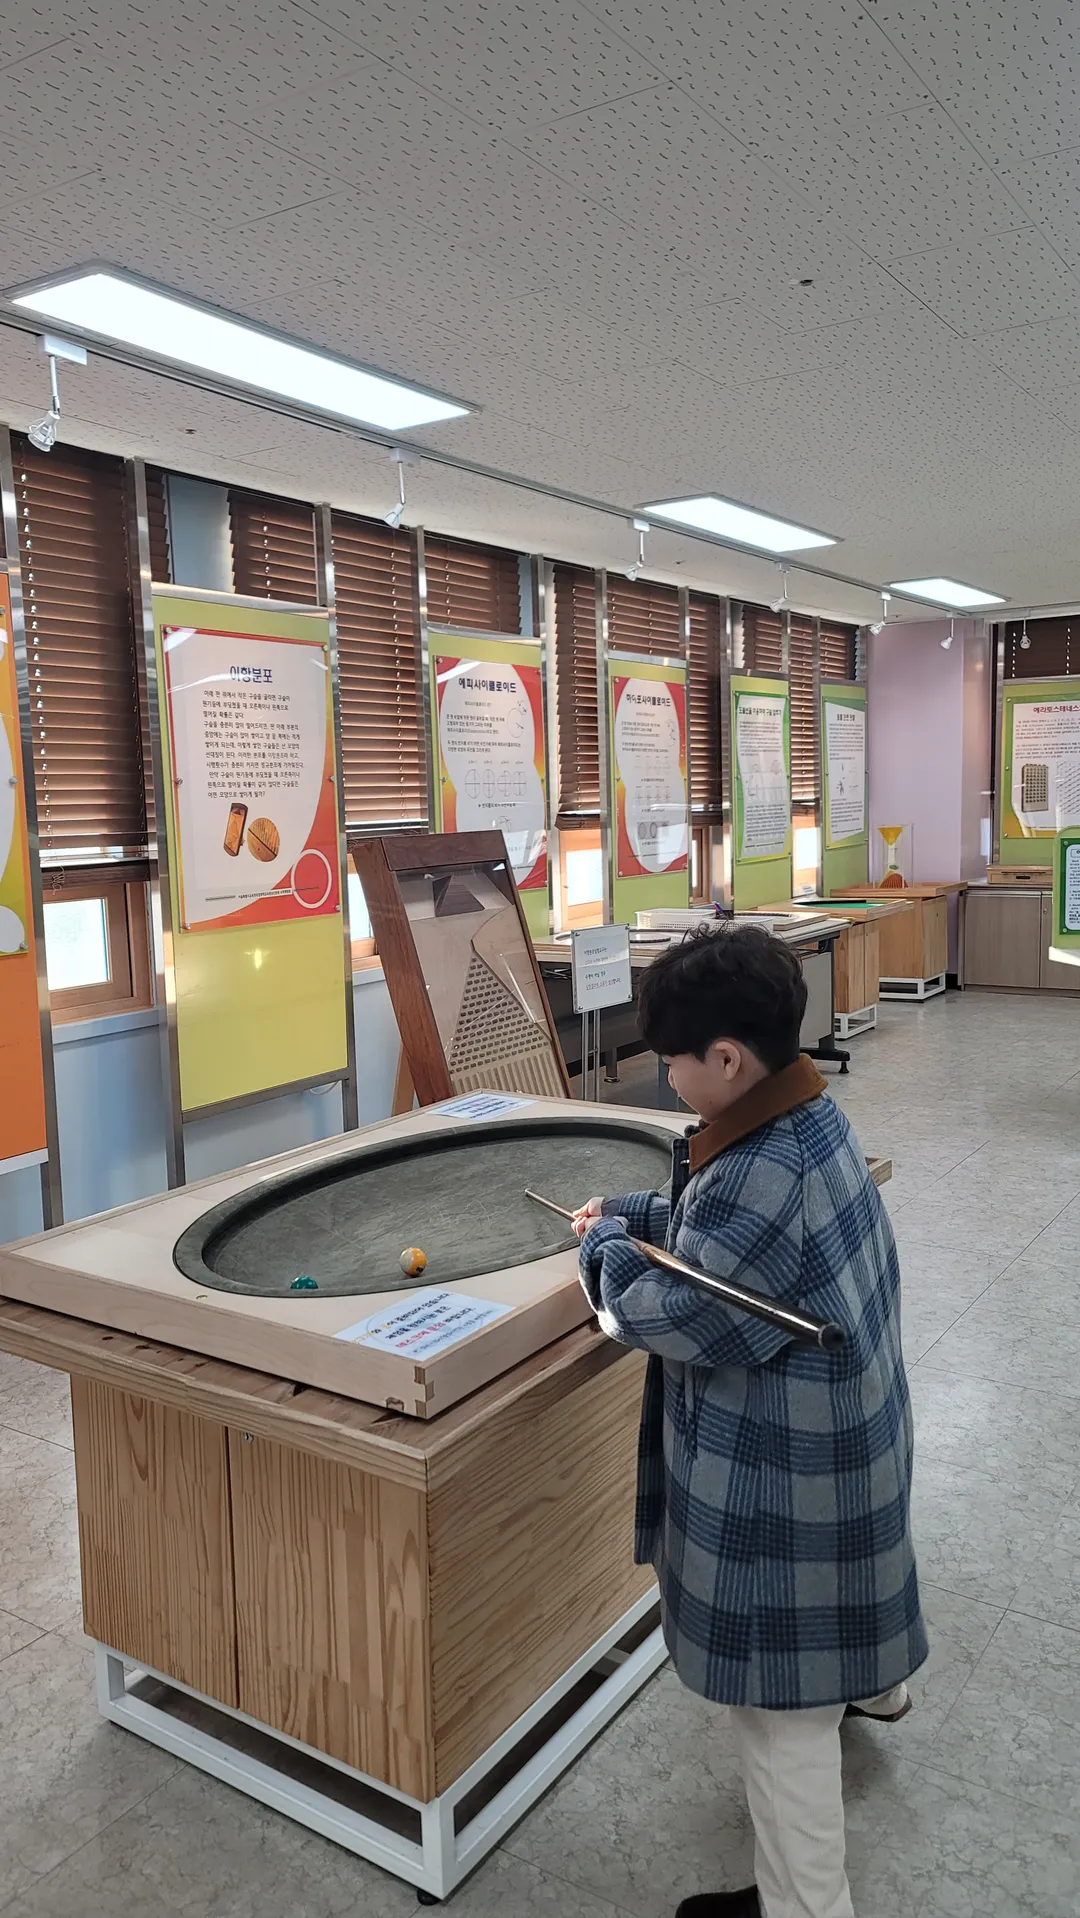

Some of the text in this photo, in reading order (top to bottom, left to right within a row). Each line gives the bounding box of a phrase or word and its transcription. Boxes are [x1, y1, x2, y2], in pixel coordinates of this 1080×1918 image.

[230, 666, 273, 683] 이항분포
[458, 678, 516, 693] 에피사이클로이드
[1033, 705, 1080, 713] 에라토스테네스
